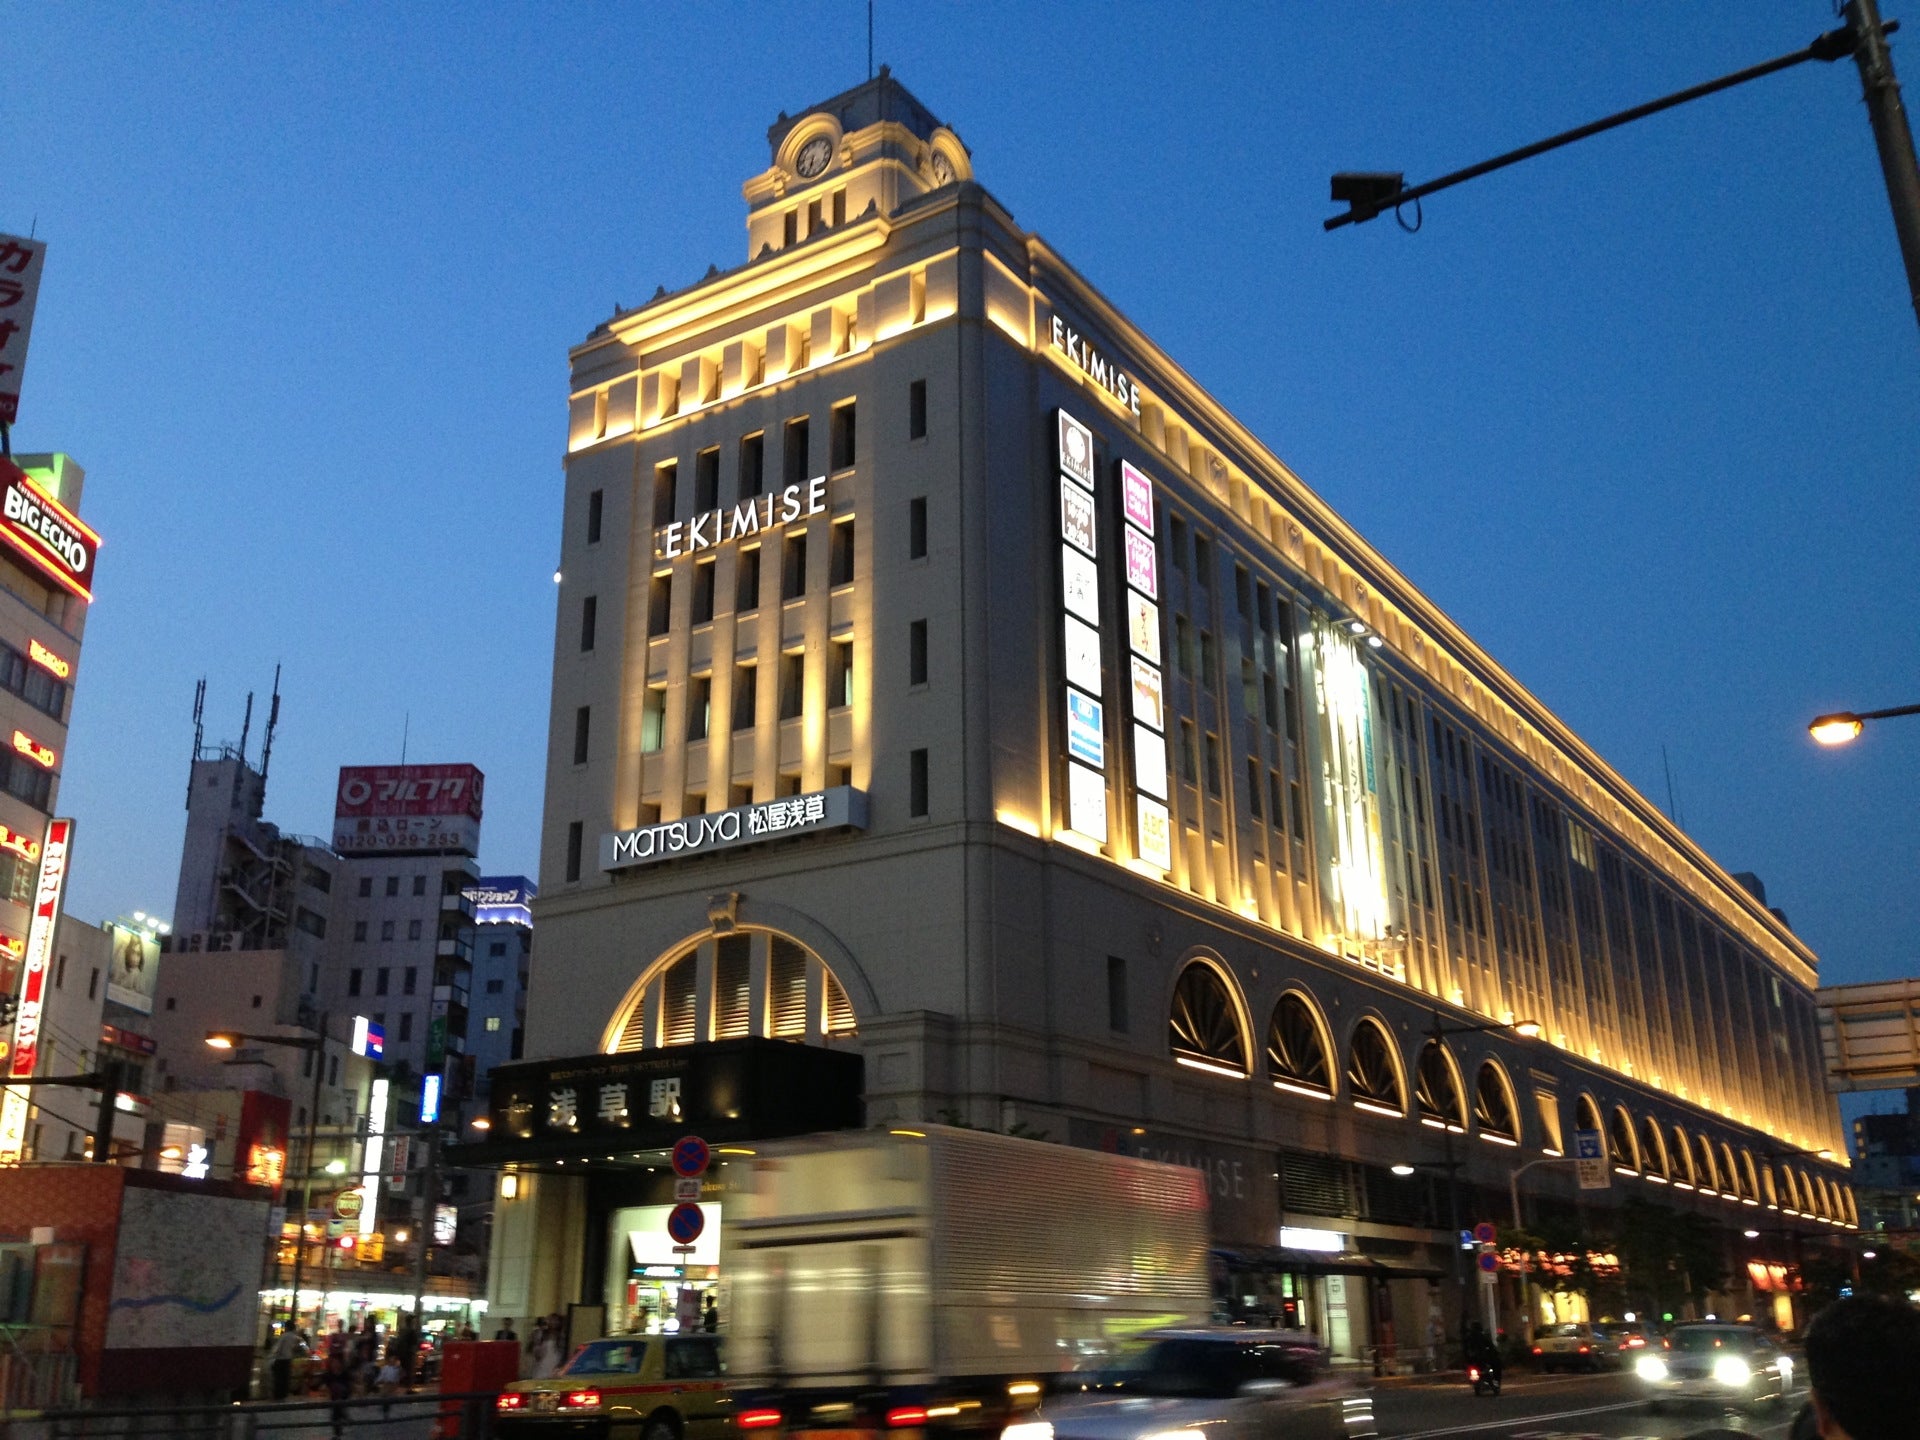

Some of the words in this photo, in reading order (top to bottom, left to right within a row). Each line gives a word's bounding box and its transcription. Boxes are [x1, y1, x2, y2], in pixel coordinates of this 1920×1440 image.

[0, 241, 33, 376] カラオ
[1052, 314, 1141, 417] EKIMISE
[3, 485, 41, 530] BIG
[40, 515, 87, 573] ECHO
[666, 475, 826, 559] EKIMISE
[374, 777, 466, 801] マルフク
[748, 794, 825, 836] 松屋浅草
[546, 1077, 682, 1128] 浅草駅
